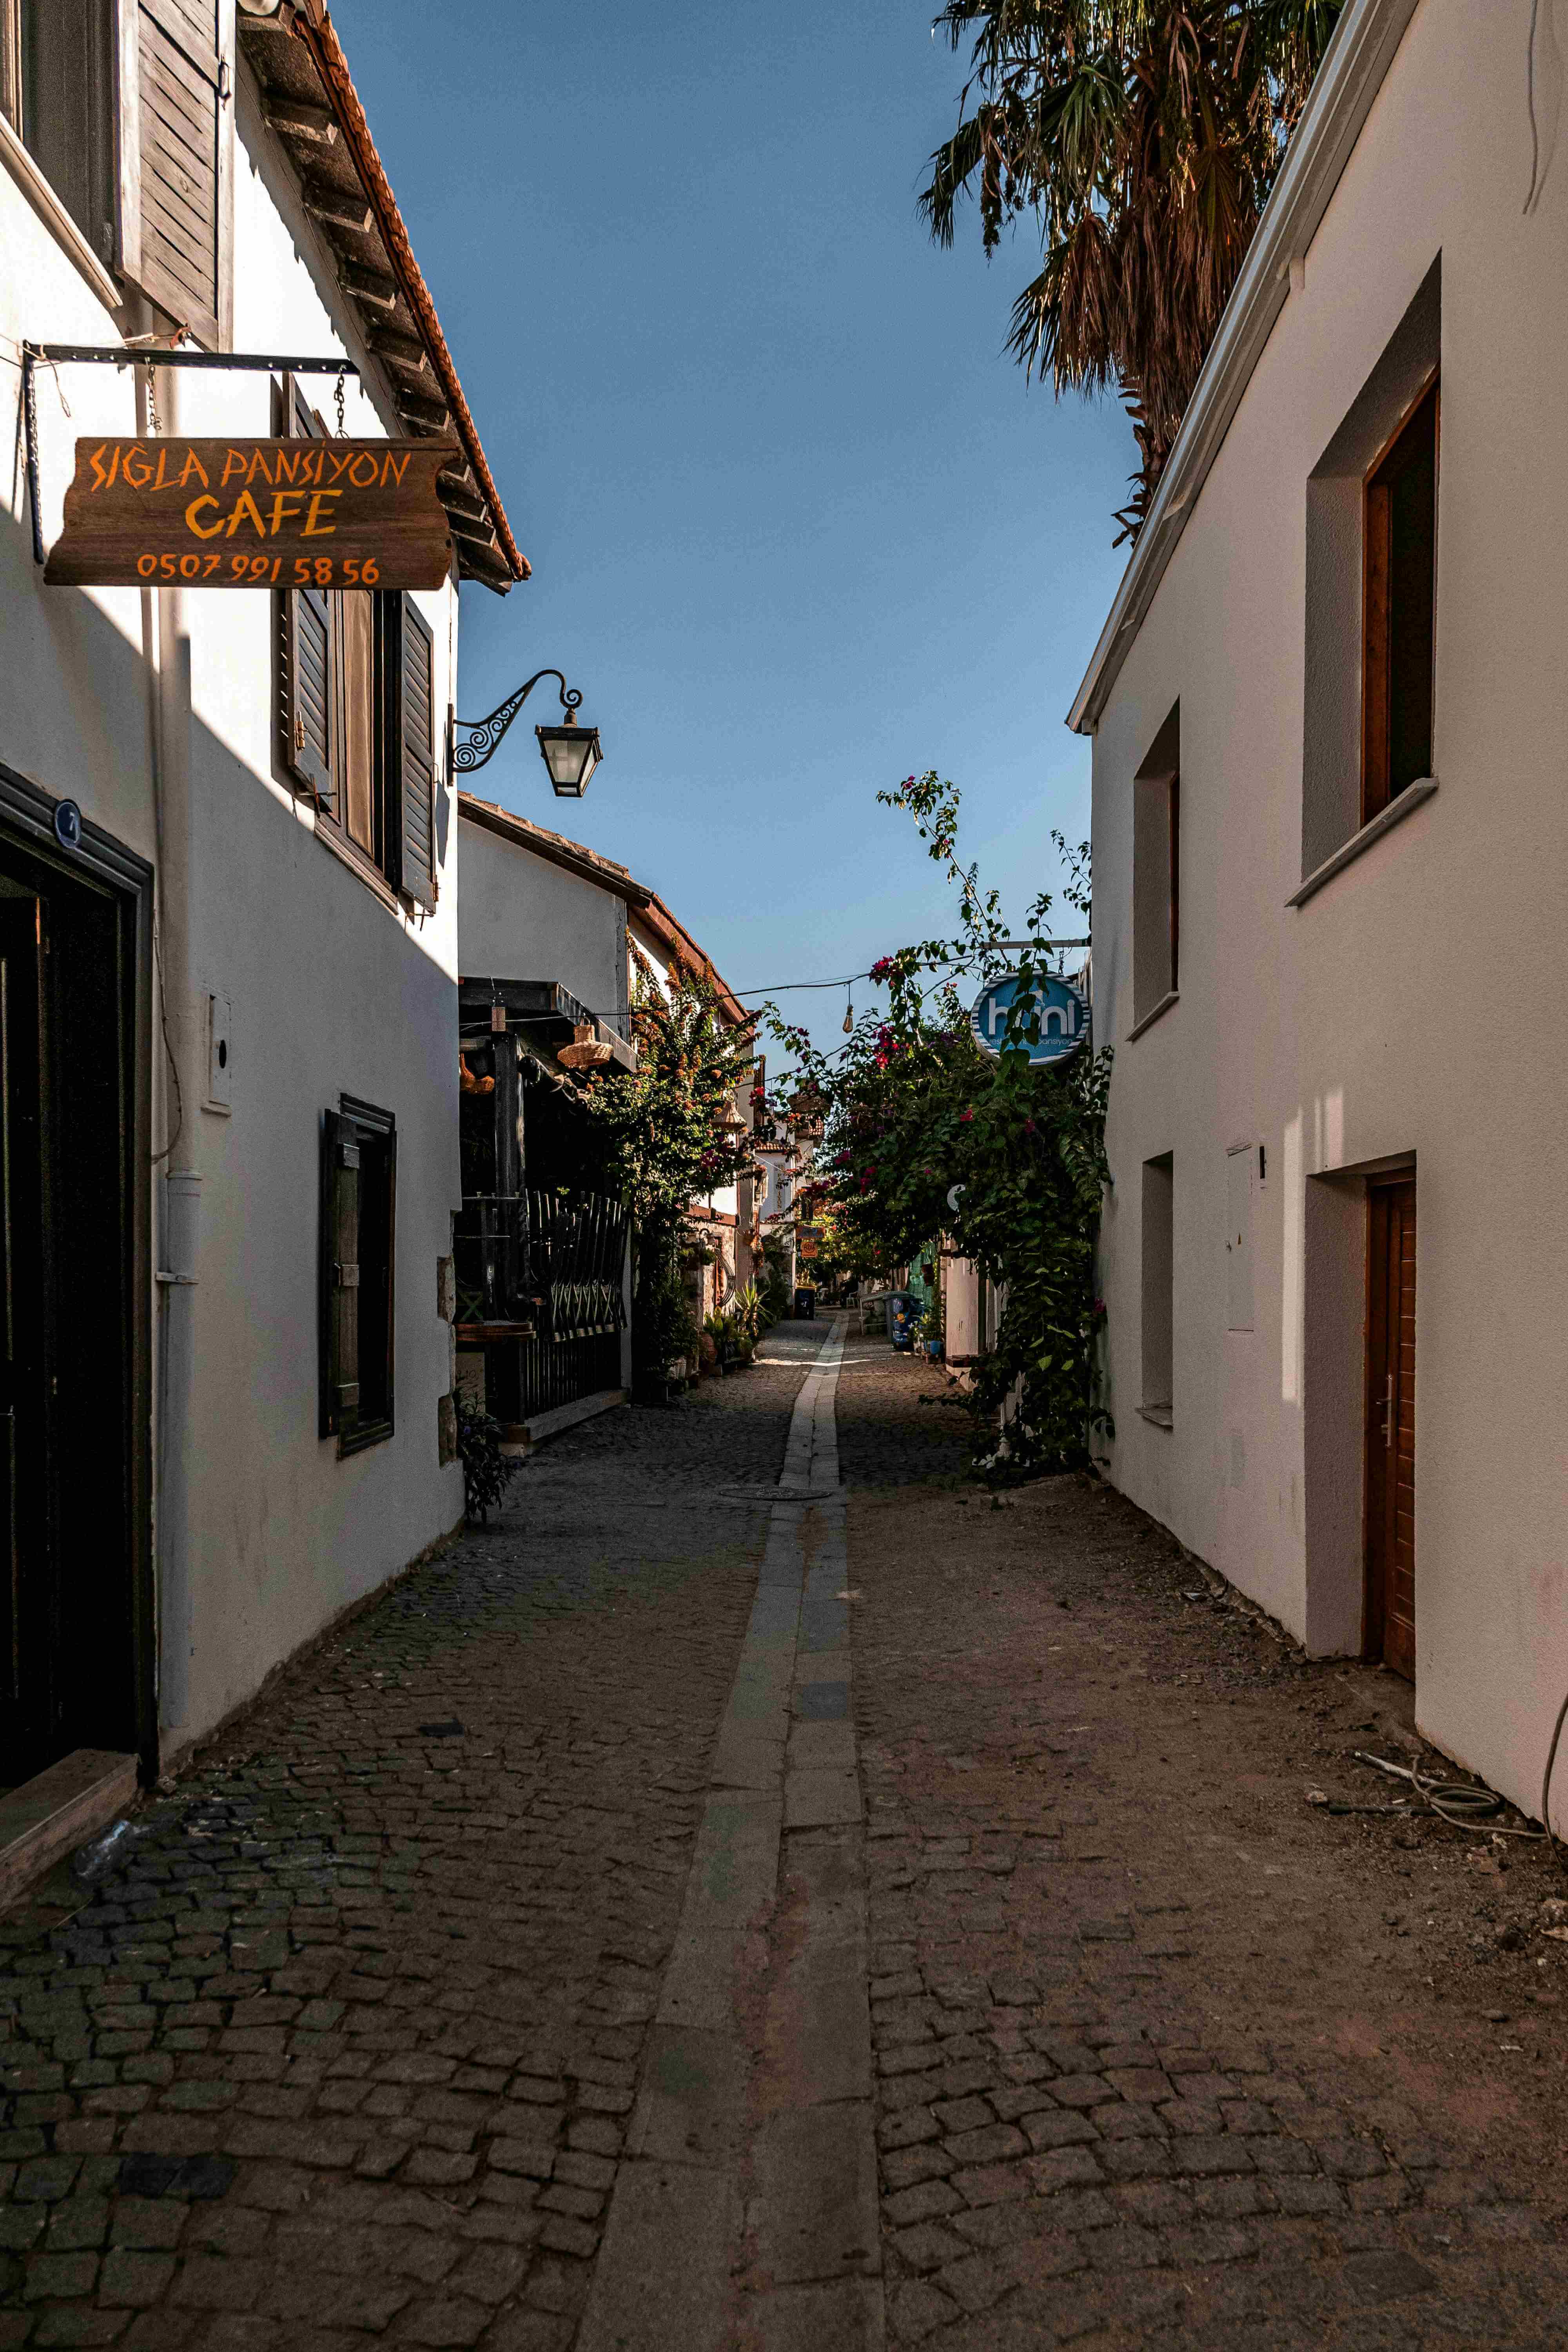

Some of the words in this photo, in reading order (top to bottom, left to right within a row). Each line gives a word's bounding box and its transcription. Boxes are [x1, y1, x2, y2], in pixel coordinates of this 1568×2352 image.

[220, 440, 412, 488] PANSİYON
[185, 489, 343, 539] CAFE
[137, 554, 221, 579] 0507
[231, 555, 282, 582] 991
[293, 557, 333, 584] 58
[341, 557, 379, 586] 56
